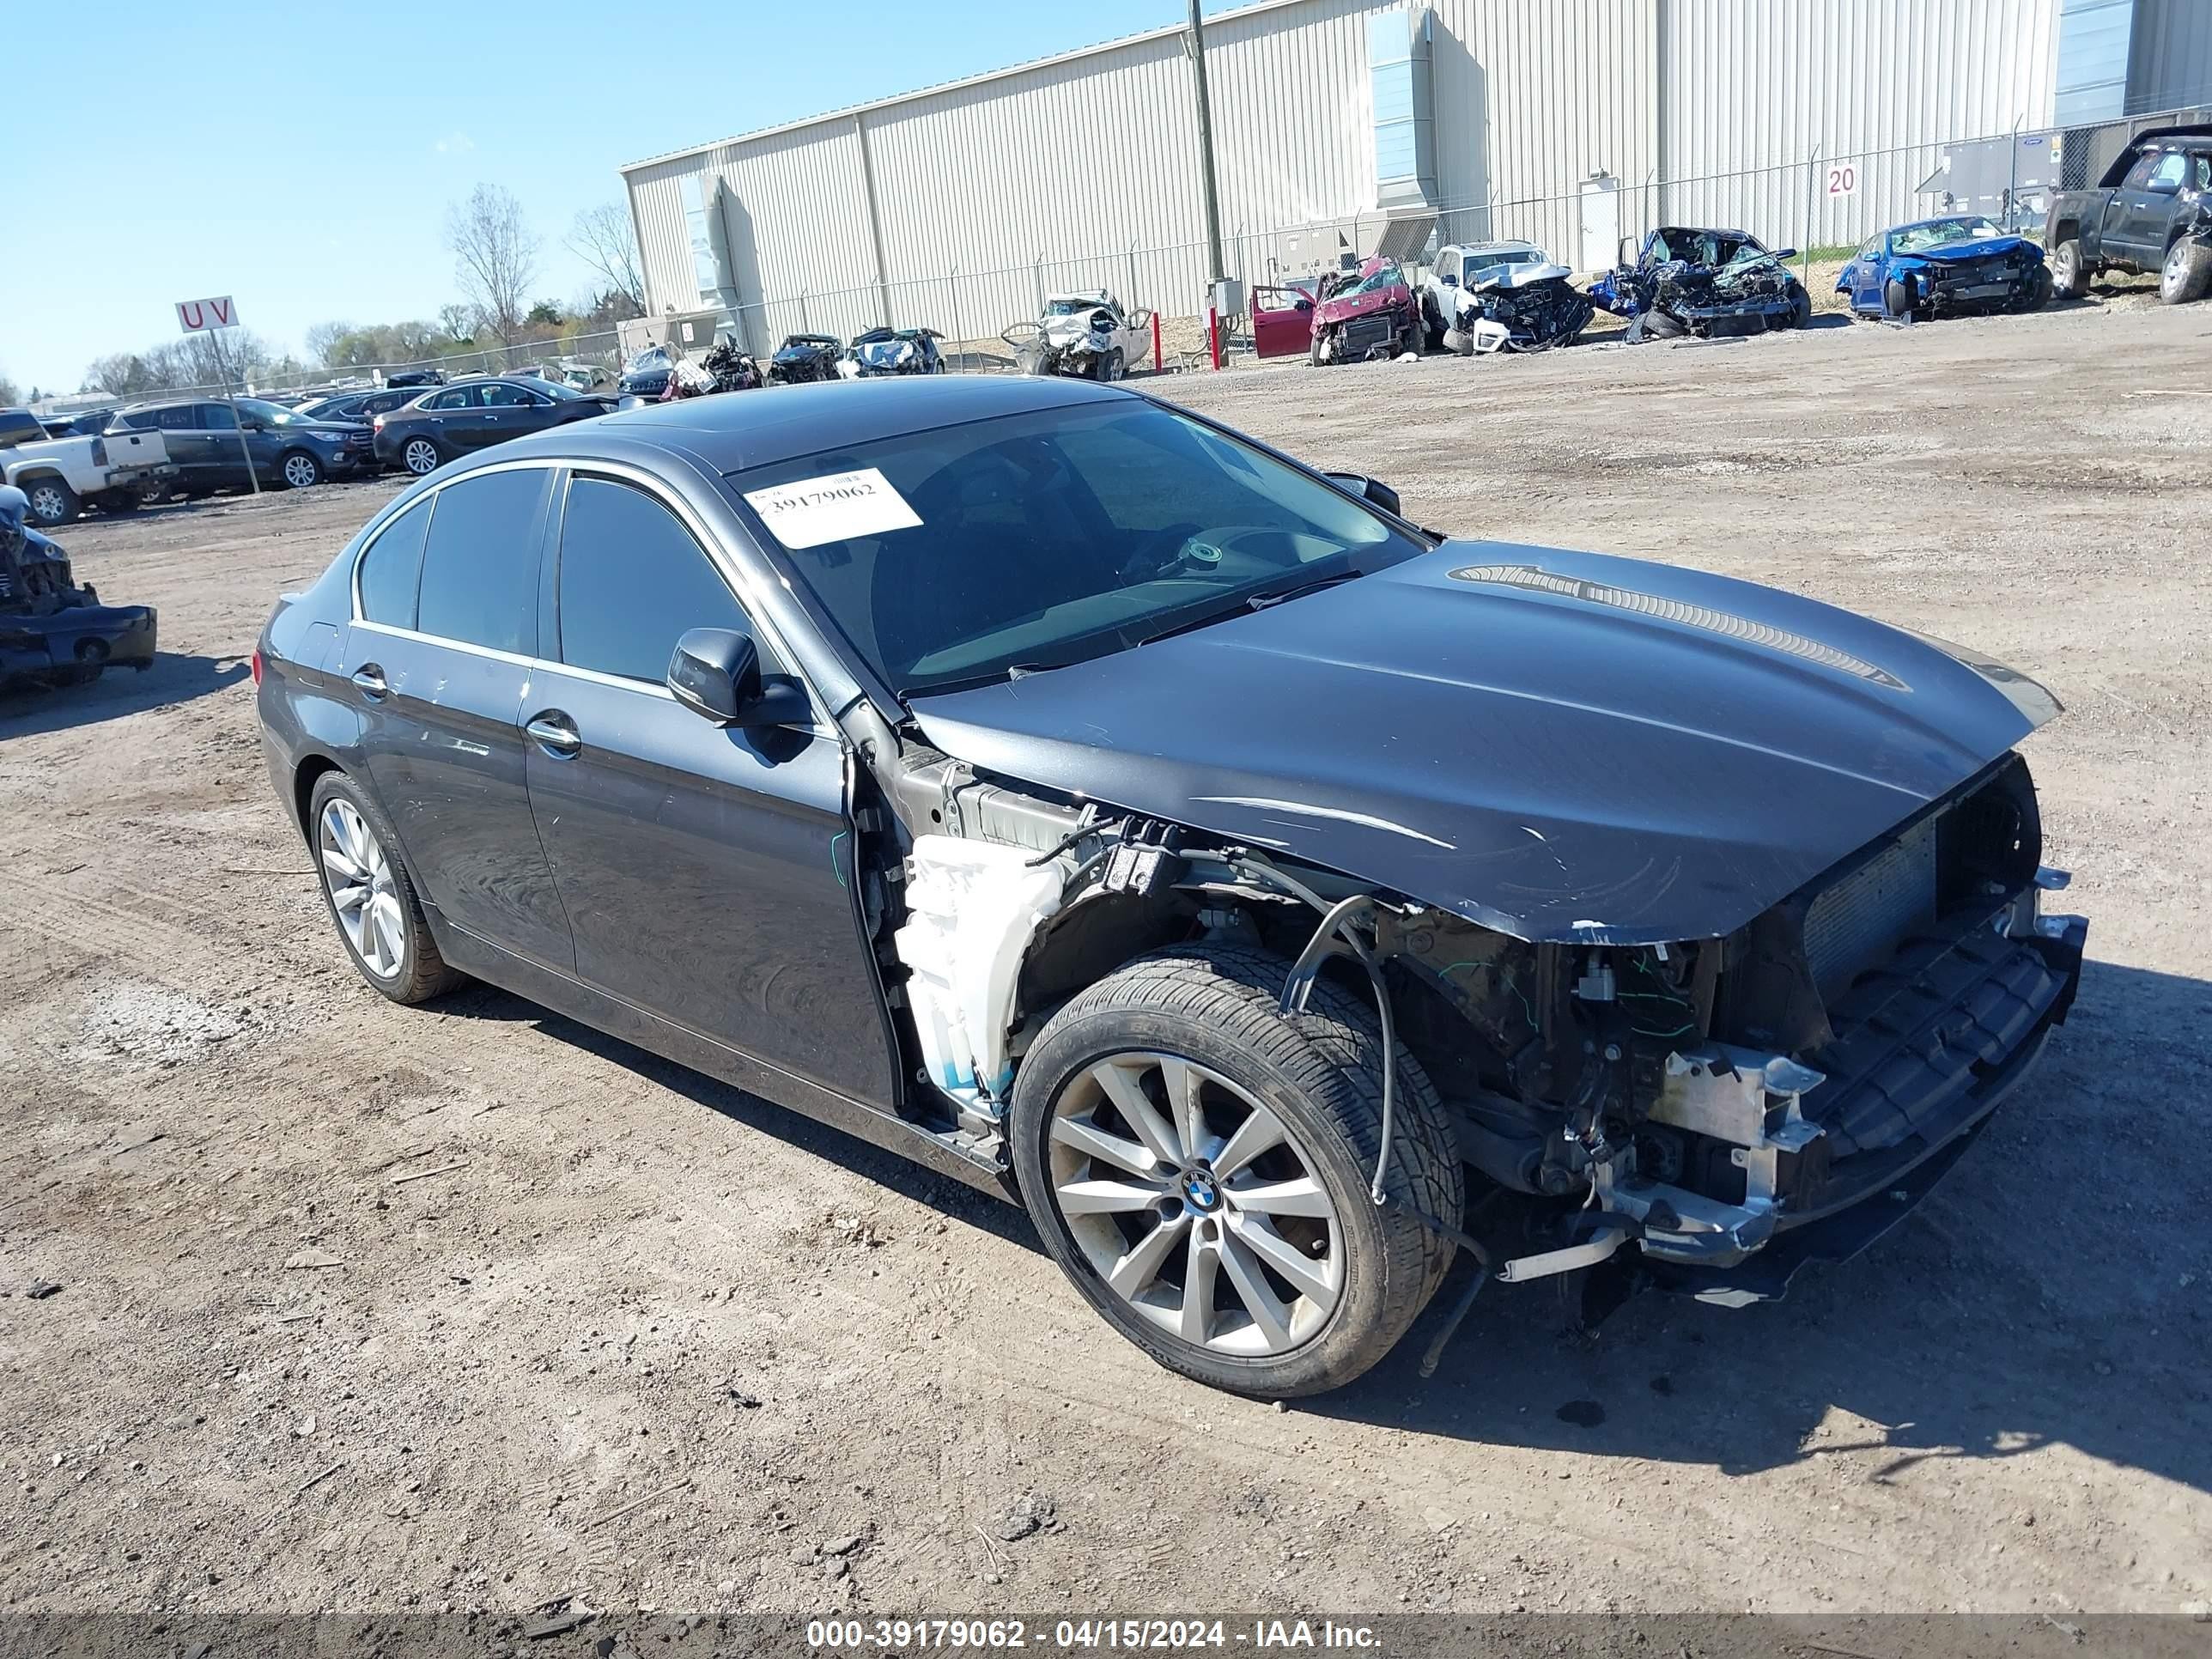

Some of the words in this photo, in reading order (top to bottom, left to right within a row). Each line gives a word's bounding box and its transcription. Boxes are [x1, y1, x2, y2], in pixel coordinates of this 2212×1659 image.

[1830, 168, 1854, 192] 20
[771, 483, 876, 514] 39179062
[1182, 1173, 1213, 1188] BMW
